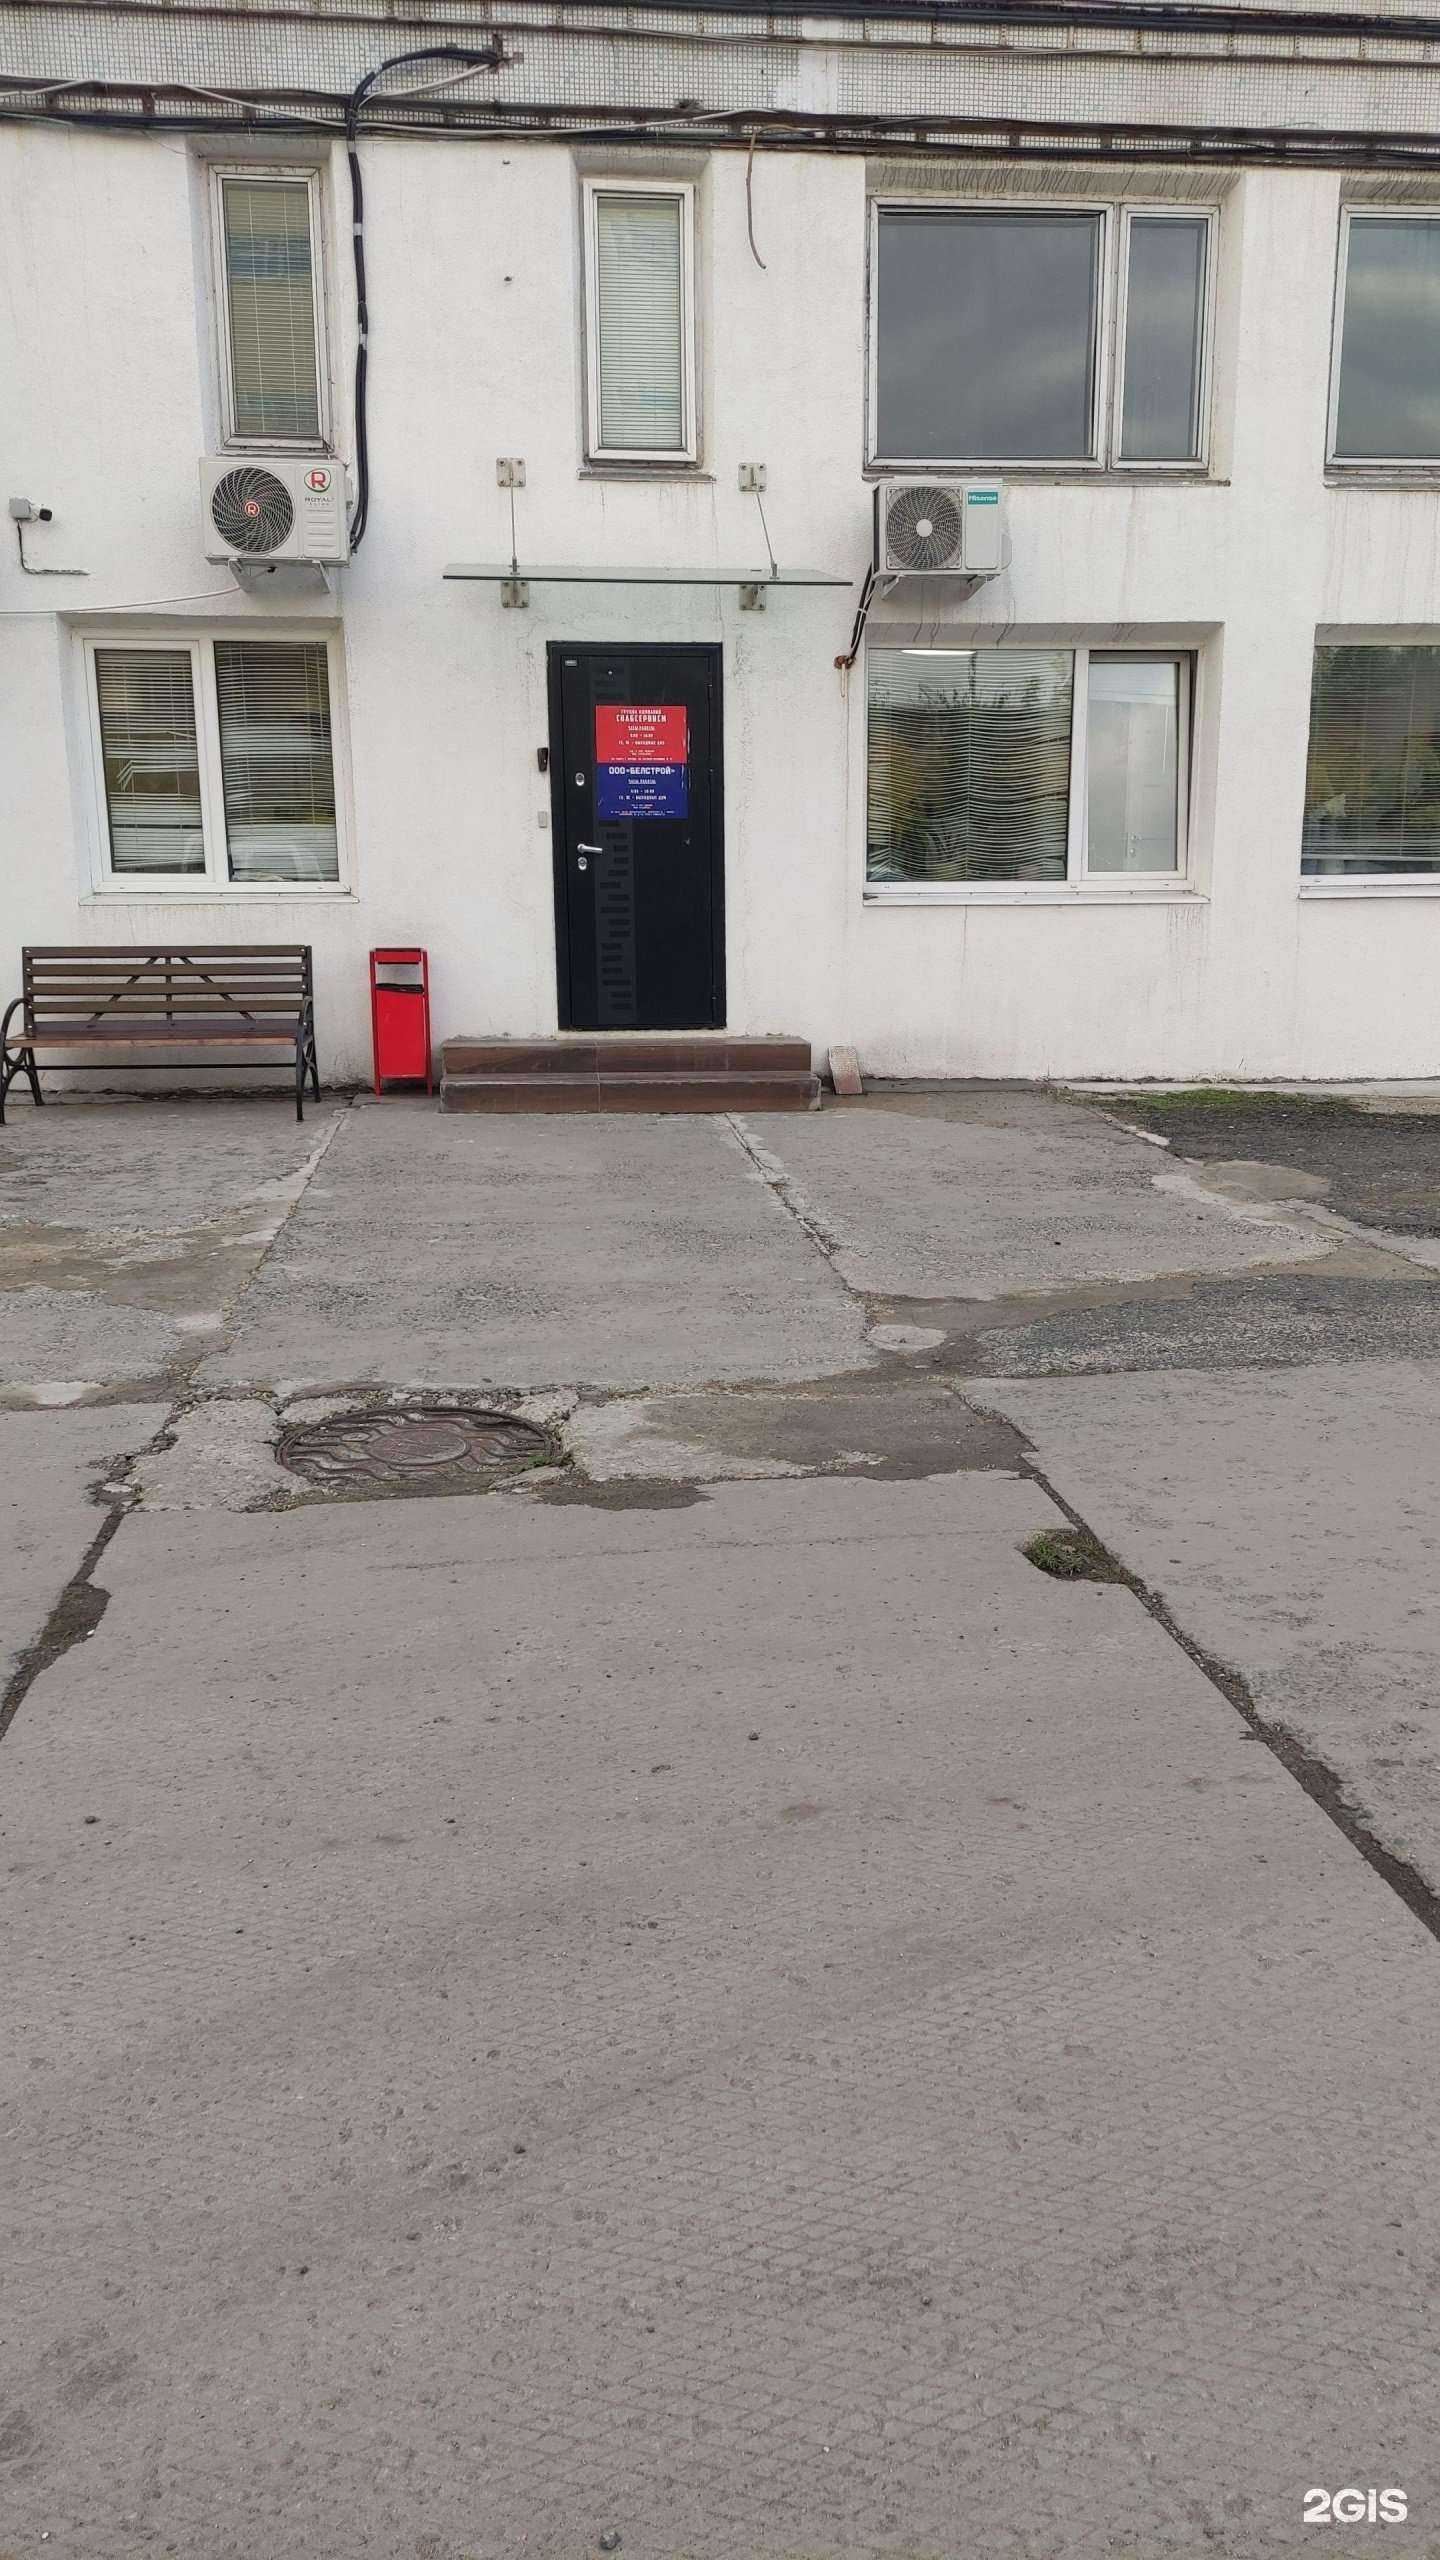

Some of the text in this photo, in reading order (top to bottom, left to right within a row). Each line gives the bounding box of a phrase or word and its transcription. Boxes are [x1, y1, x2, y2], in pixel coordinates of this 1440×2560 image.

[311, 470, 326, 488] R
[968, 494, 997, 503] Hisense
[608, 766, 625, 775] ООО
